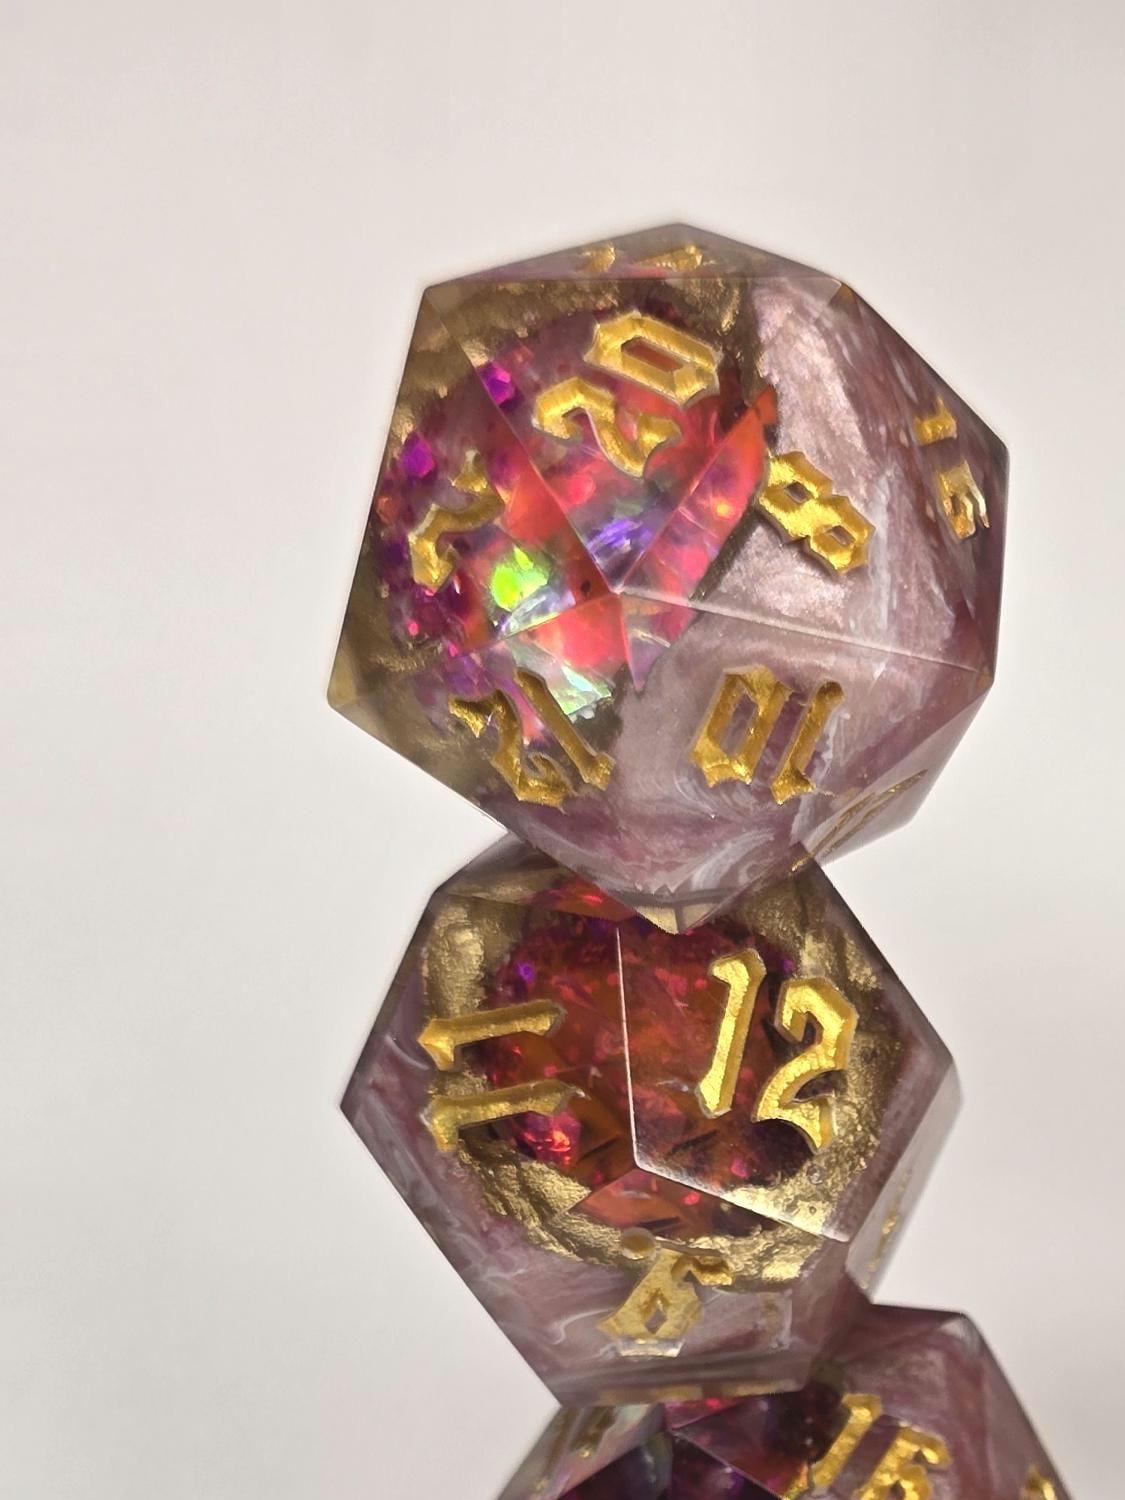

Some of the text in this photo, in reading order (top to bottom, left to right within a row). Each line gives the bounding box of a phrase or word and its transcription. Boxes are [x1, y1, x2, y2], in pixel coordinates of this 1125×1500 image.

[534, 311, 722, 477] 20
[754, 452, 876, 573] 8
[688, 665, 846, 805] 10
[418, 1000, 575, 1152] 11
[698, 948, 858, 1153] 12
